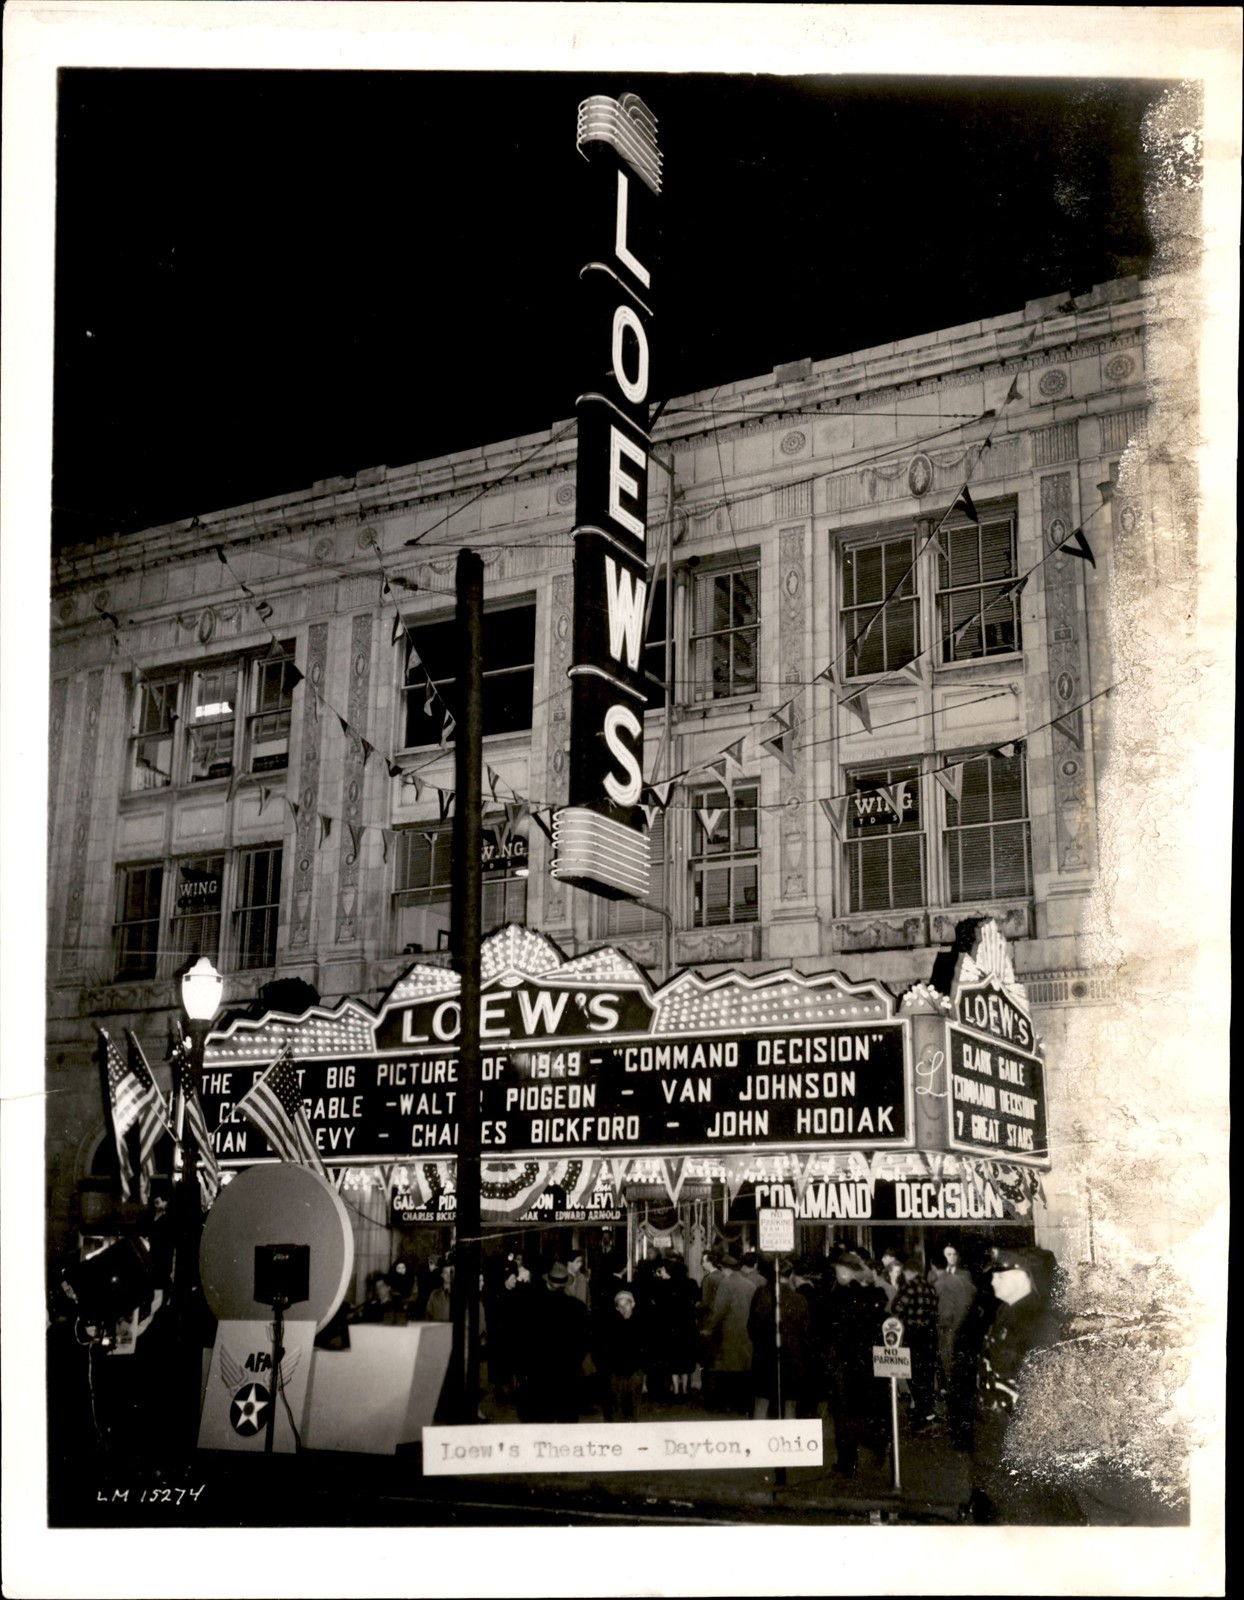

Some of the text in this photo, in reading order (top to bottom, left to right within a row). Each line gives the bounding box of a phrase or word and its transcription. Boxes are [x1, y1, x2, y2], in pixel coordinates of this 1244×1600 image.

[602, 169, 651, 808] LOEWS
[481, 841, 524, 860] WNG
[180, 880, 218, 896] WING
[402, 990, 620, 1042] LOEW'S
[964, 993, 1030, 1045] LOEW'S
[202, 1073, 232, 1094] THE
[326, 1066, 355, 1088] BIG
[377, 1059, 459, 1086] PICTURE
[482, 1057, 507, 1080] OF
[530, 1051, 581, 1078] 1949
[757, 1034, 883, 1066] DECISION"
[962, 1043, 1026, 1087] CLARK GABLE
[302, 1096, 363, 1120] GABLE
[506, 1084, 596, 1111] PIDGEON
[662, 1078, 711, 1103] VAN
[739, 1071, 856, 1101] JOHNSON
[411, 1120, 507, 1147] CHAES
[531, 1115, 640, 1143] BICKFORD
[707, 1110, 769, 1137] JOHN
[797, 1106, 894, 1134] HODIAK
[956, 1110, 1034, 1151] 7 GREAT STARS
[402, 1211, 434, 1222] CHARLES
[436, 1211, 457, 1222] BICKF
[555, 1211, 586, 1221] EDWARD
[588, 1210, 621, 1221] ARNOLD
[755, 1182, 1004, 1219] COMMAND DECISION
[245, 1352, 272, 1373] AFA
[873, 1355, 909, 1365] PARKING
